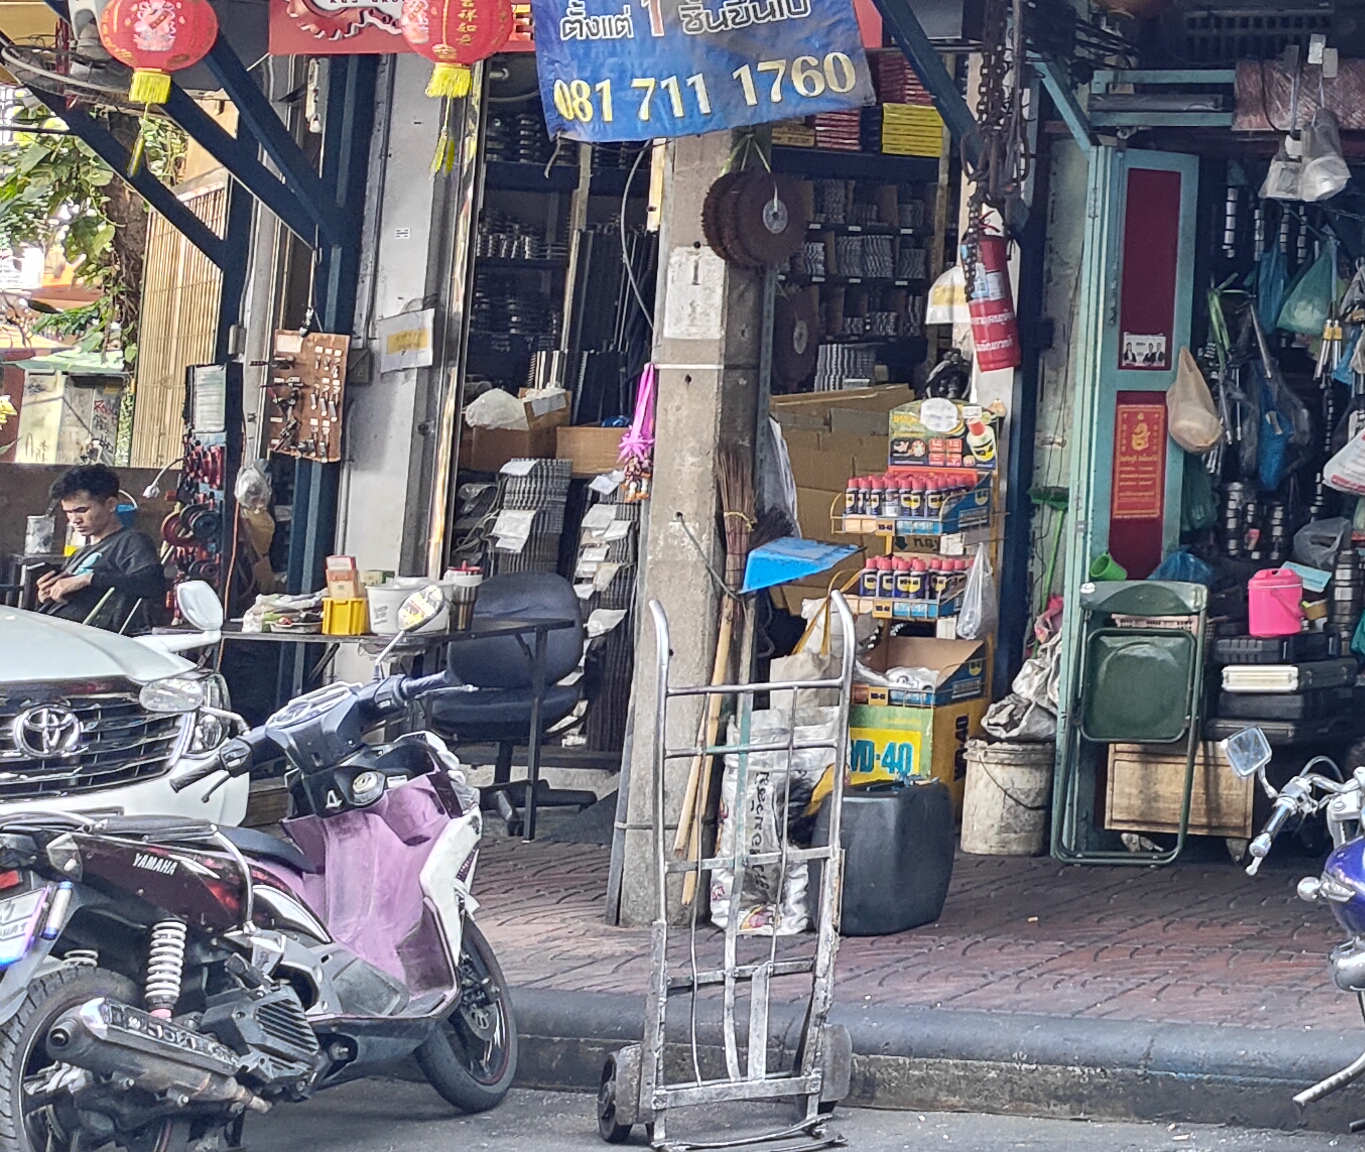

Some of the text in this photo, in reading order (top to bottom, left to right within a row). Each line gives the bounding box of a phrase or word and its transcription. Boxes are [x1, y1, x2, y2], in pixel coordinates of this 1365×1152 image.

[553, 51, 857, 123] 081 711 1760
[132, 852, 179, 876] YAMAHA
